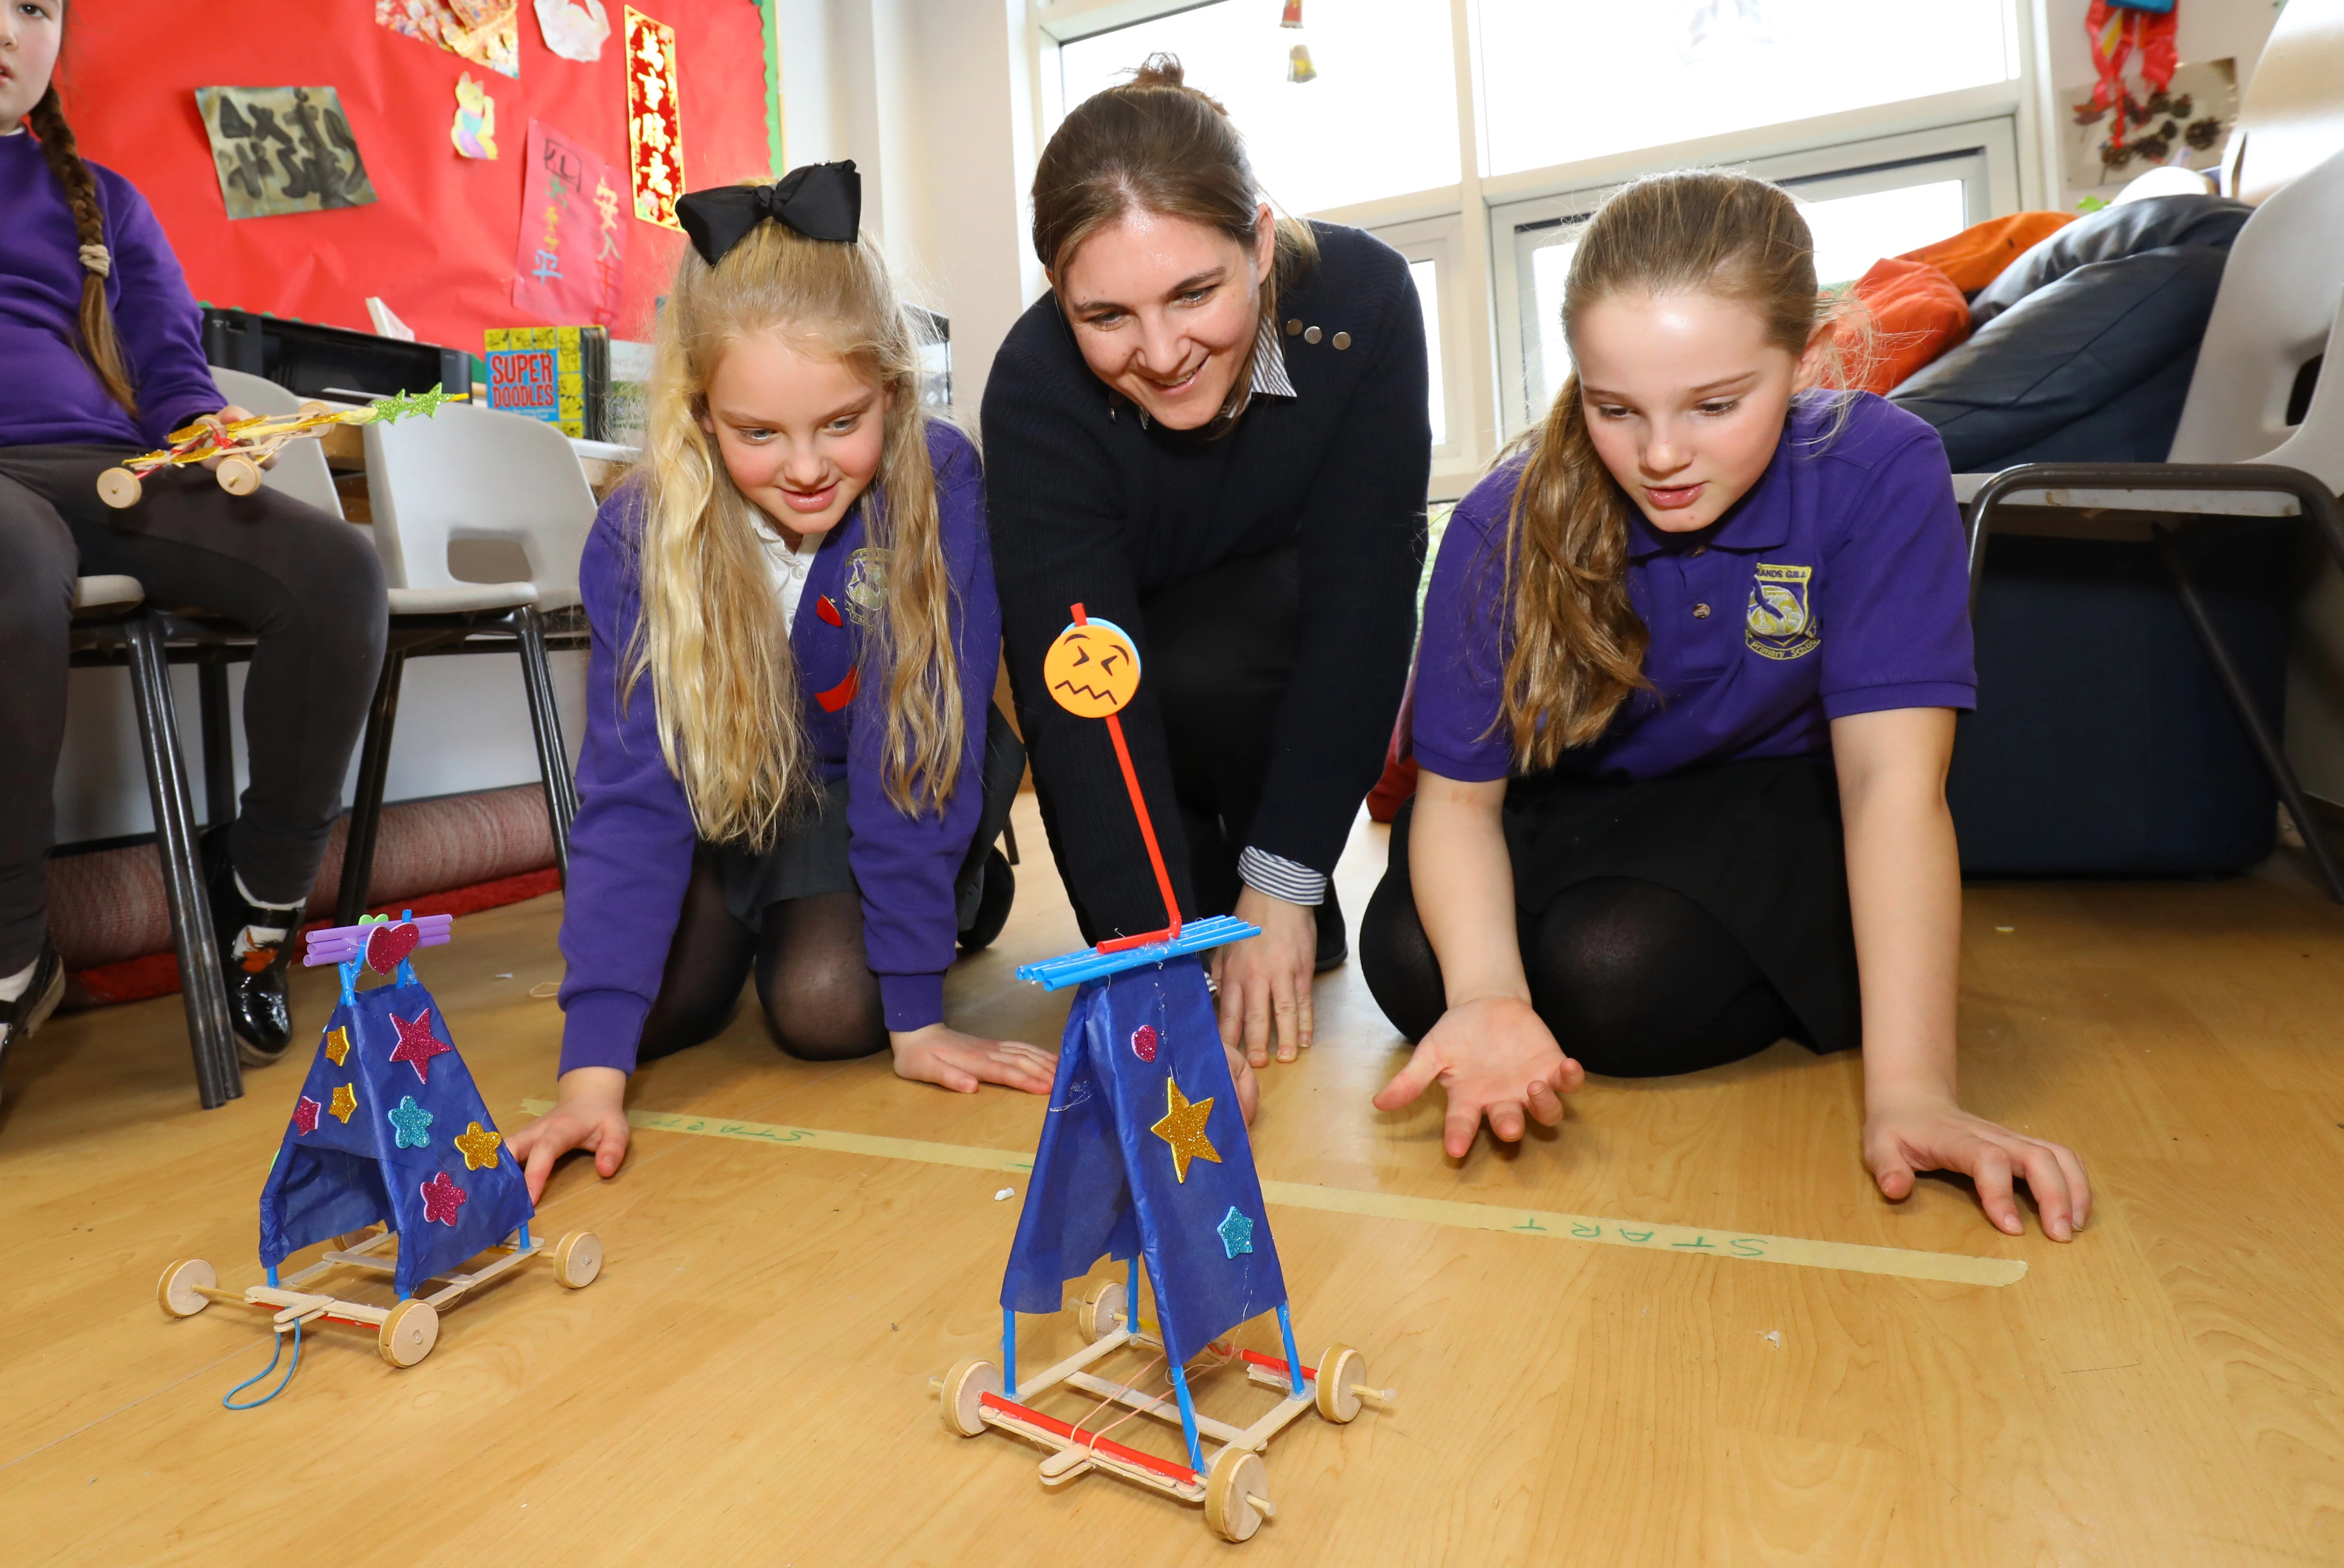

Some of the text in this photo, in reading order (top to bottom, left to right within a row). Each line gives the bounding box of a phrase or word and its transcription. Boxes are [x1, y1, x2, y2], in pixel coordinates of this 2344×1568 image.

[491, 353, 553, 384] SUPER
[492, 384, 554, 408] DOODLES
[1751, 641, 1786, 658] Primary
[1512, 1218, 1769, 1256] START
